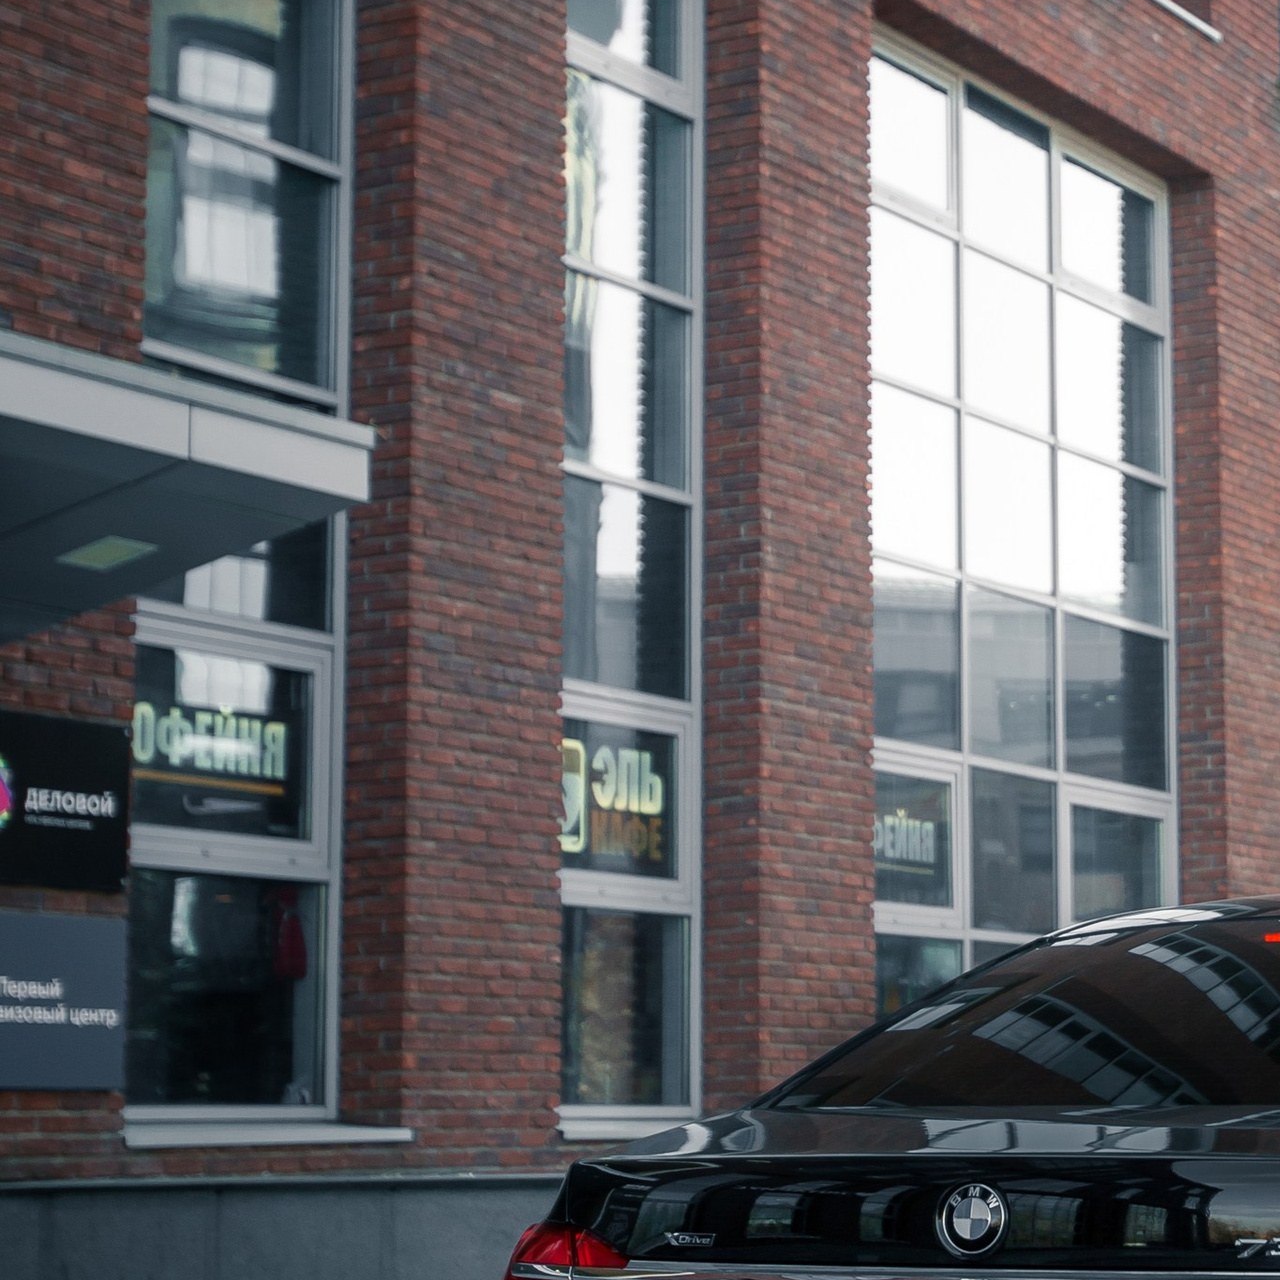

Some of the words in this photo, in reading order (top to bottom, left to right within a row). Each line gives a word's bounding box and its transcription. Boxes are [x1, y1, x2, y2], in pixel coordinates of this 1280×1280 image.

[591, 745, 663, 815] ЭЛЬ
[25, 787, 118, 818] ДЕЛОВОЙ
[591, 810, 663, 860] КАФЕ
[69, 1008, 119, 1029] центр
[950, 1186, 999, 1209] BMW
